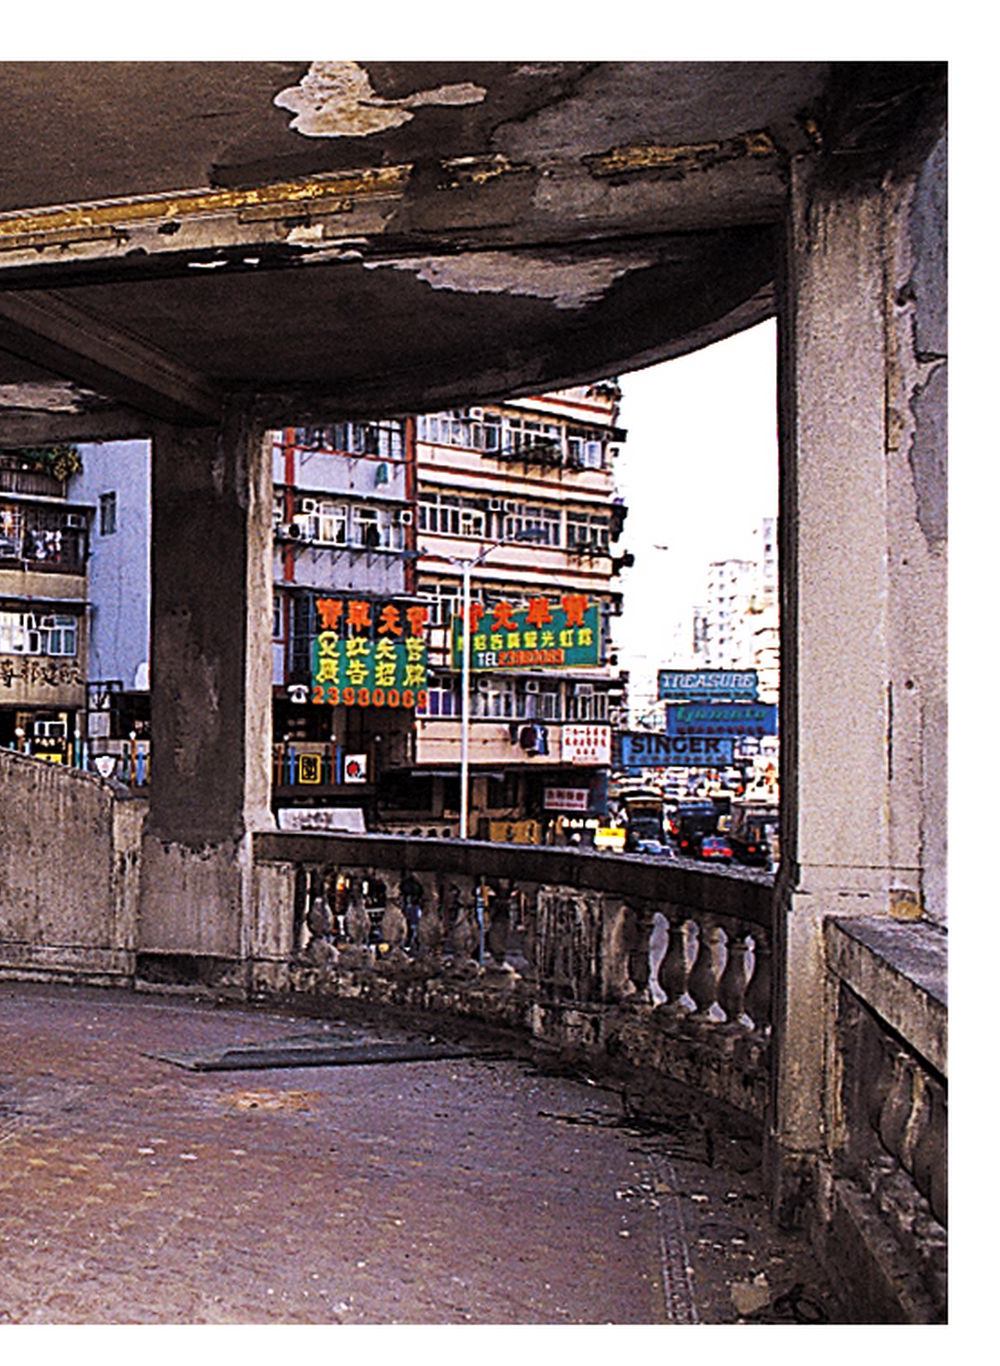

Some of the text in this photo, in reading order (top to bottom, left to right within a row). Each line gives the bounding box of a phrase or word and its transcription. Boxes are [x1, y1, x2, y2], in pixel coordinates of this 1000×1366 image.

[662, 673, 756, 688] TREASURE
[312, 686, 428, 708] 23980069
[630, 736, 721, 753] SINGER
